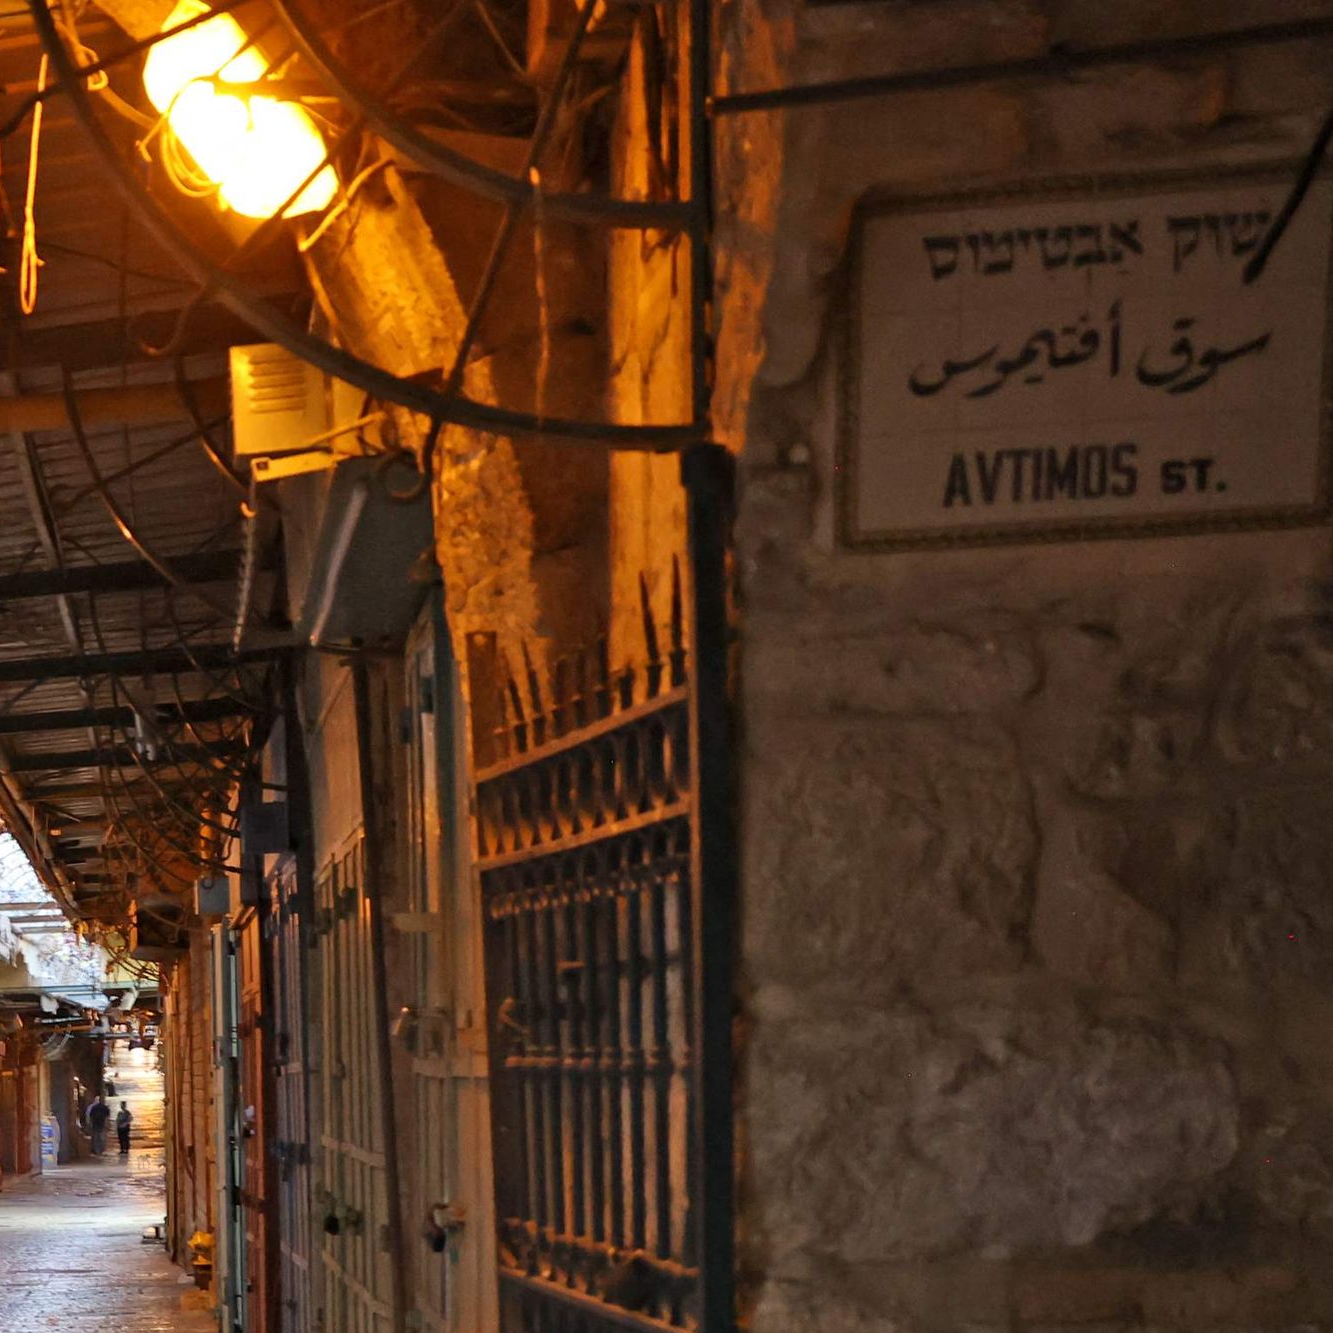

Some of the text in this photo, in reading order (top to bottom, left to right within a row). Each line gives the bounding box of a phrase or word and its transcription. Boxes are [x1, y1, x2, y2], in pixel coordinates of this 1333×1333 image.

[1166, 212, 1271, 272] שוק
[908, 299, 1272, 397] سوق أفتيموس
[943, 444, 1228, 508] AVTIMOS ST.
